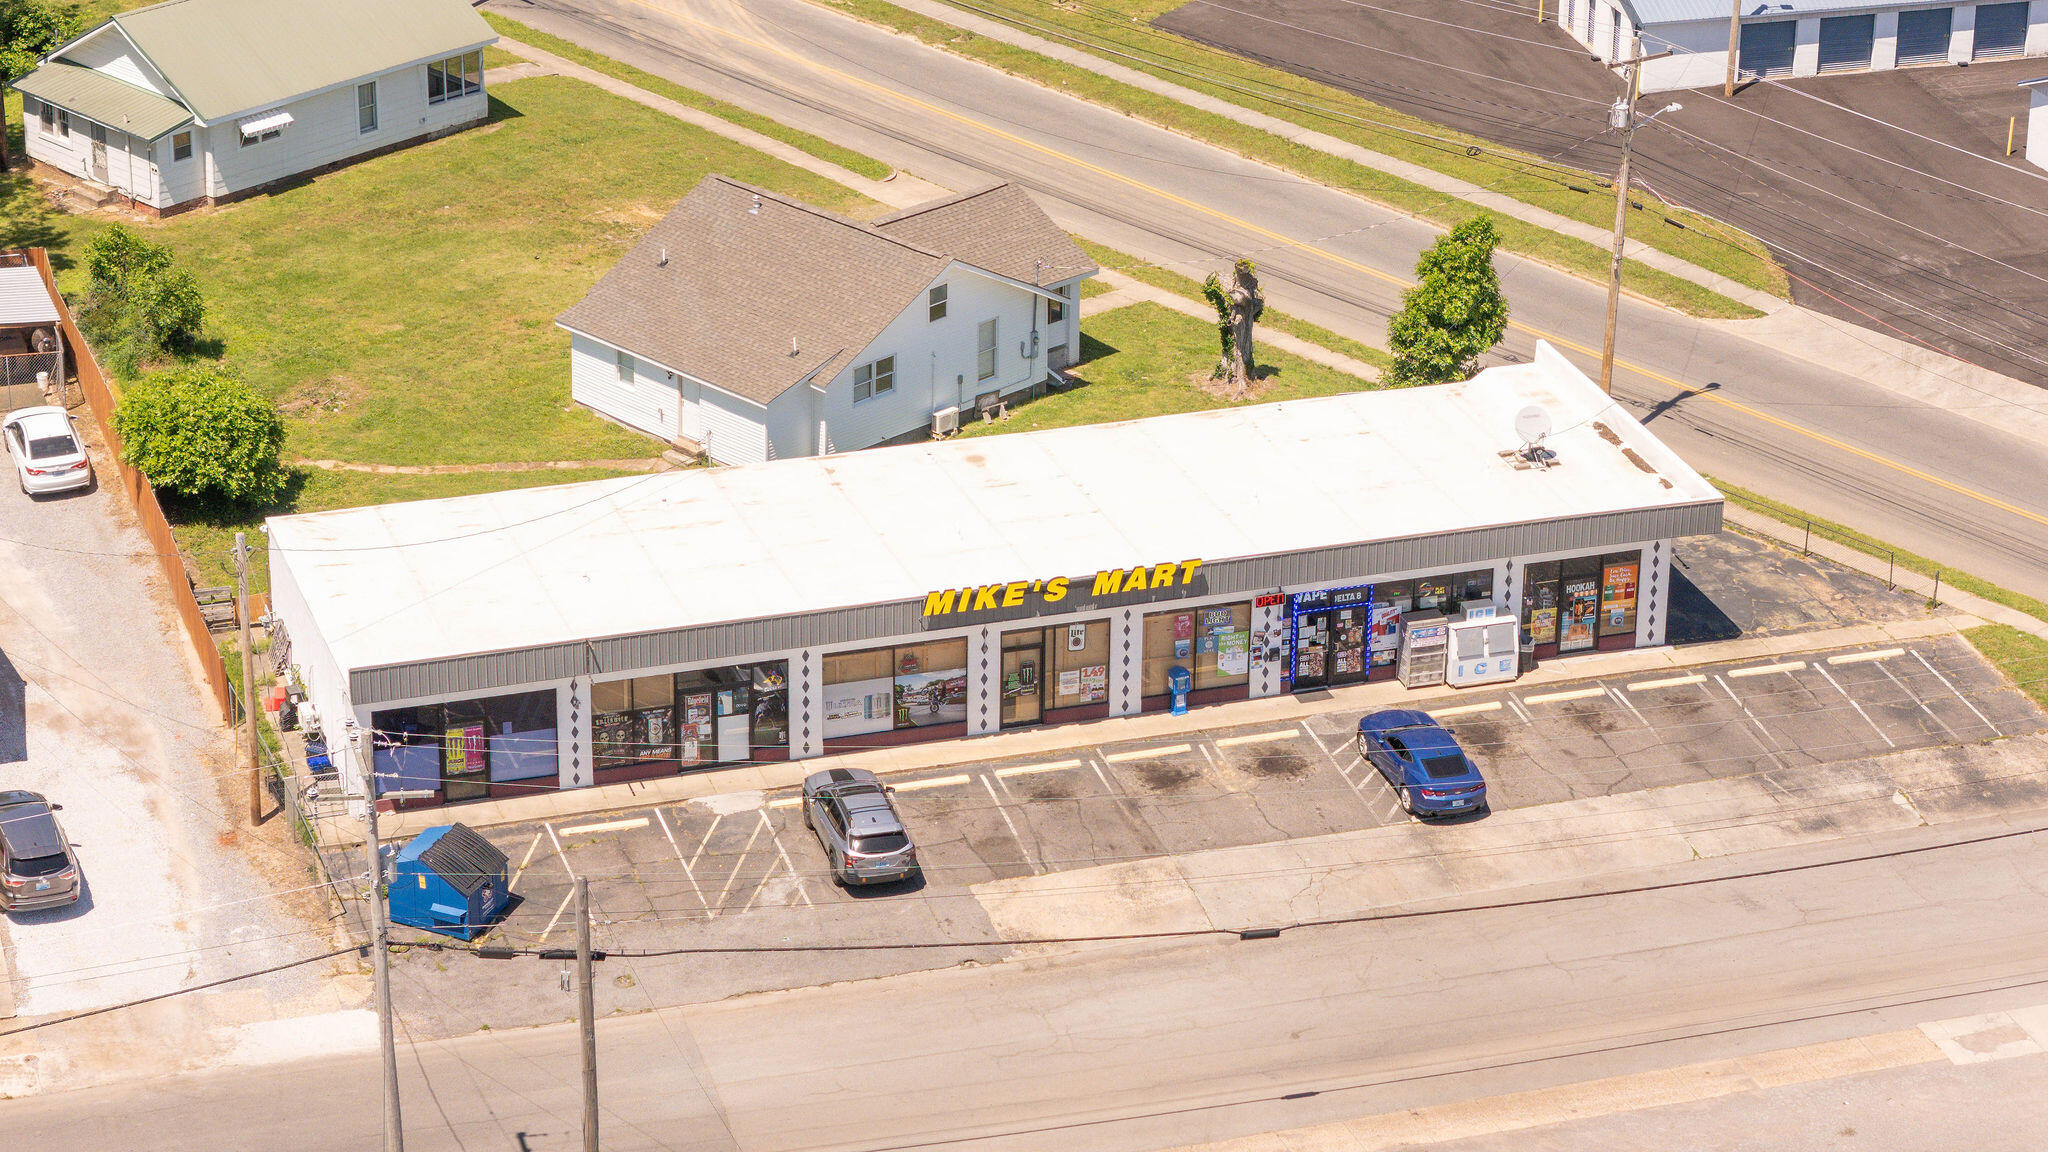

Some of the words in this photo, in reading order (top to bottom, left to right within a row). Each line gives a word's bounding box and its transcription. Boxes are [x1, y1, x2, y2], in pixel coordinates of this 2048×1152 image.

[922, 575, 1070, 617] MIKE'S
[1091, 558, 1202, 597] MART
[1566, 581, 1595, 594] HOOKAH
[1256, 594, 1285, 608] OPEN
[1356, 592, 1362, 600] 8
[1208, 610, 1228, 618] BUD
[1469, 608, 1494, 619] ICE
[1204, 616, 1231, 624] LIGHT
[1458, 659, 1512, 677] ICE
